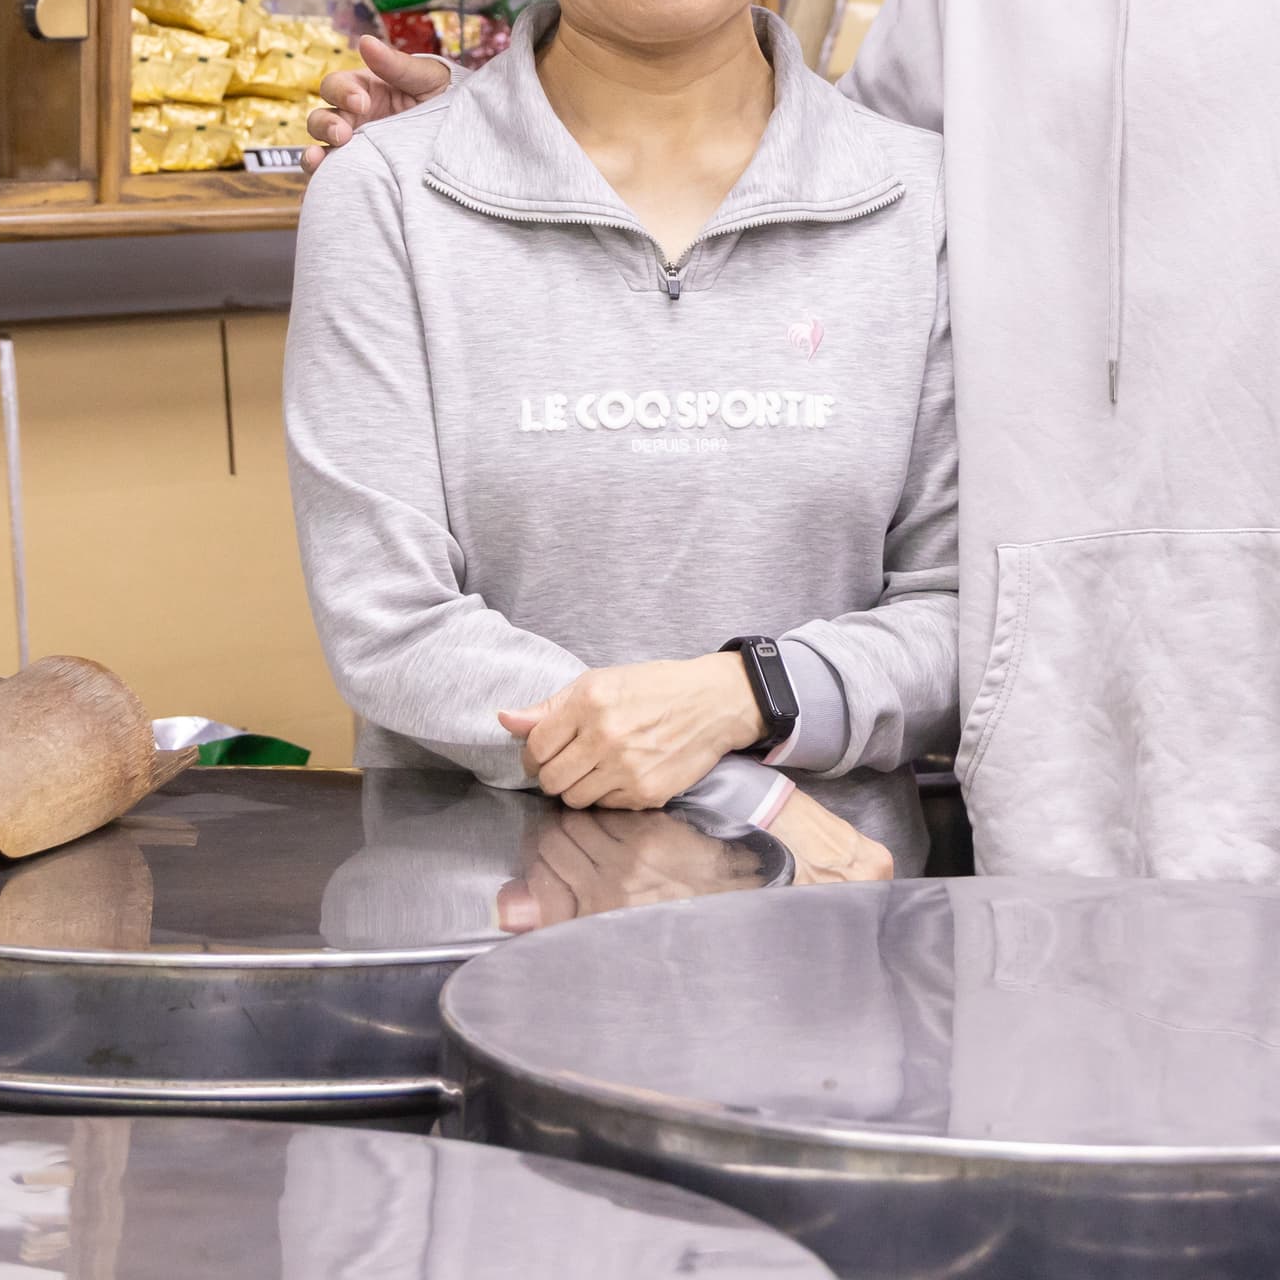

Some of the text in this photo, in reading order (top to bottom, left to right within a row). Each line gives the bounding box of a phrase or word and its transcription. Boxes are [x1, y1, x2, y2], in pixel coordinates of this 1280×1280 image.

[519, 389, 836, 432] LE COQ SPORTIF
[631, 438, 690, 453] DEPUIS
